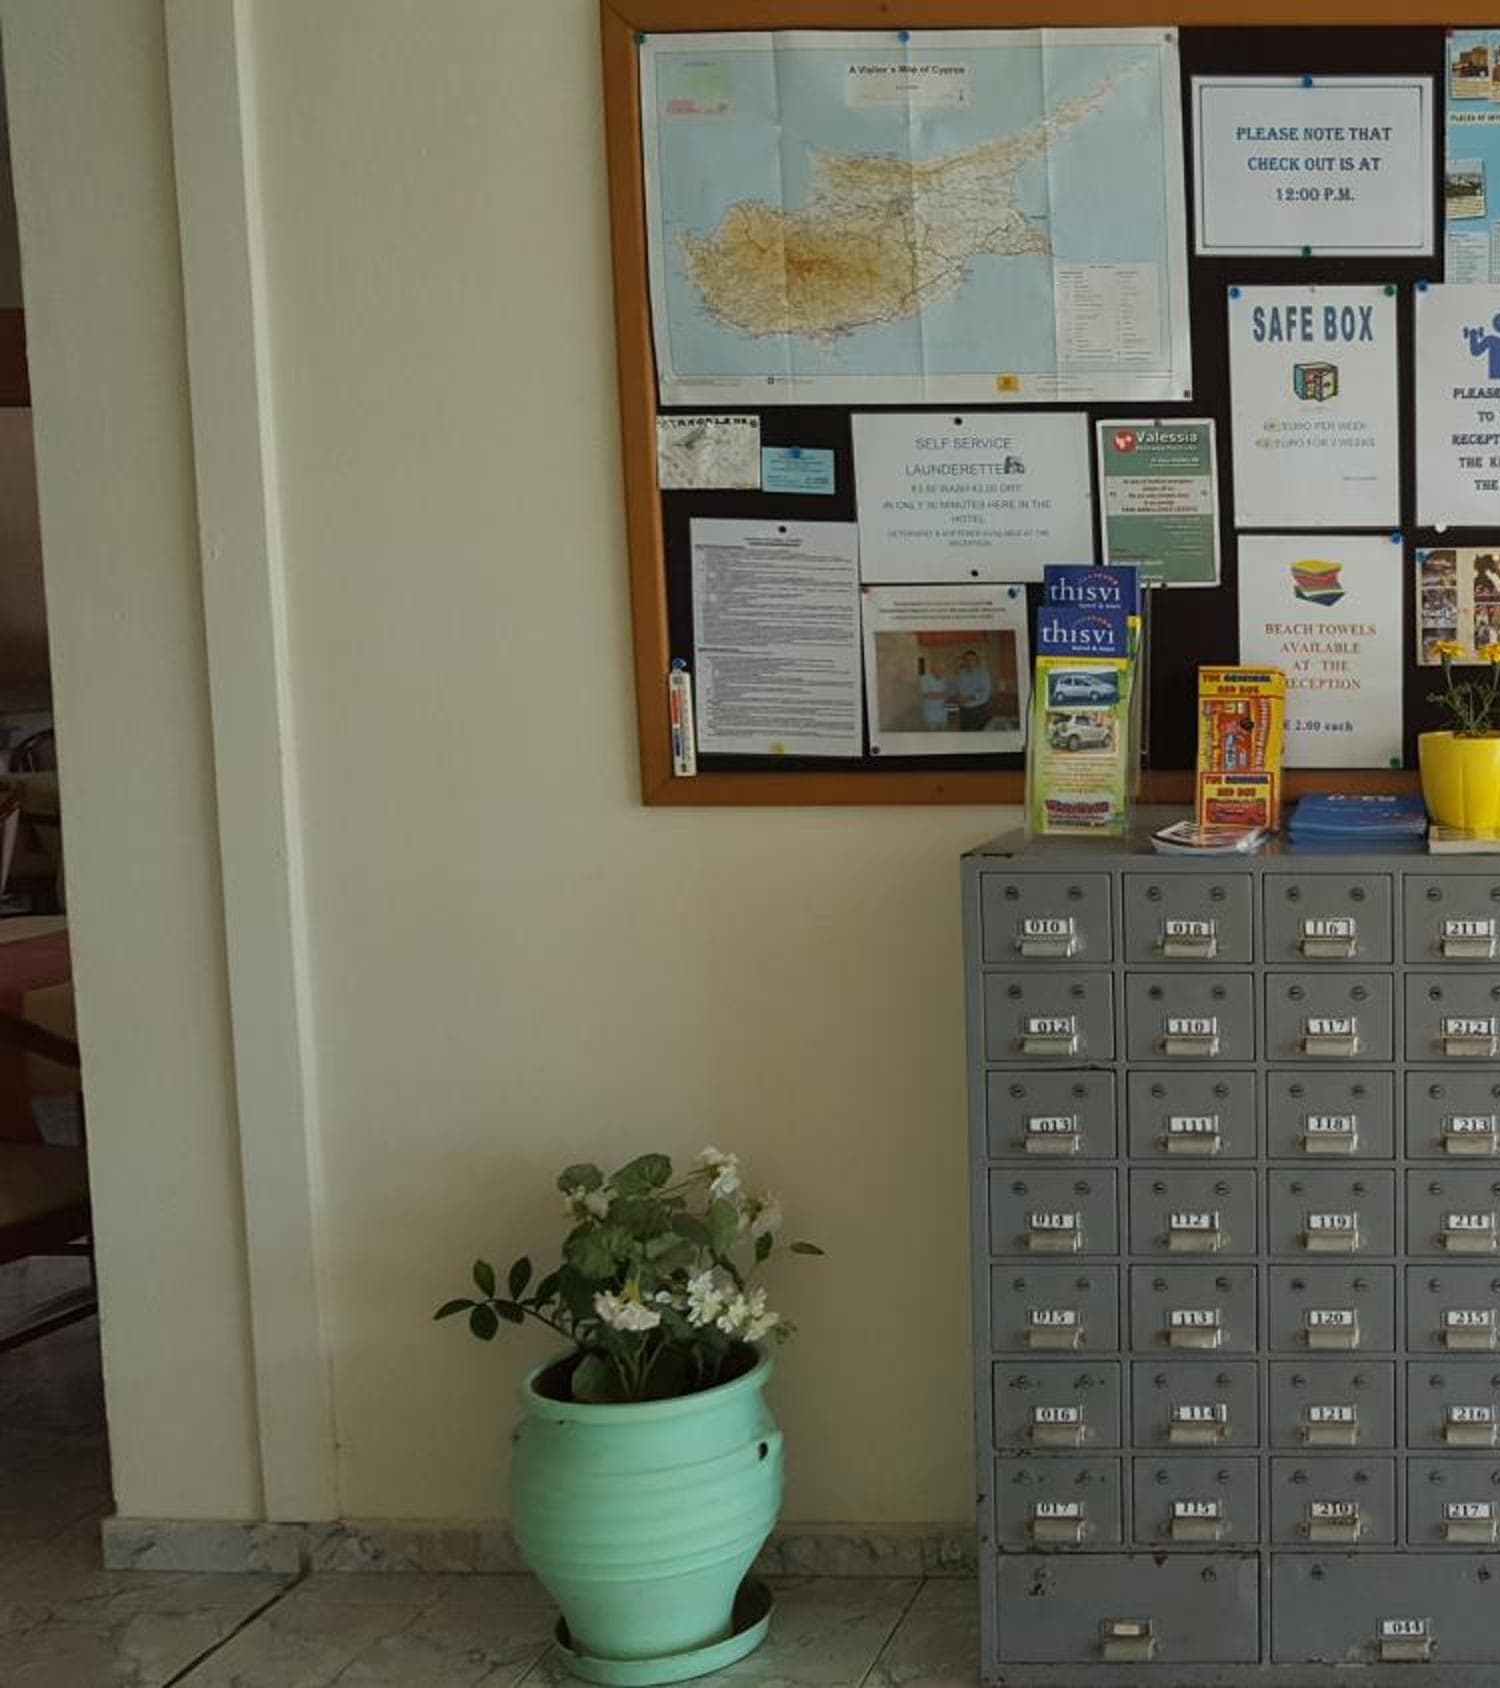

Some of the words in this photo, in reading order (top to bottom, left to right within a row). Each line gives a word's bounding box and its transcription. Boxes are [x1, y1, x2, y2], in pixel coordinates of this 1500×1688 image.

[1236, 127, 1299, 141] PLEASE
[1303, 127, 1345, 141] NOTE
[1349, 127, 1392, 141] THAT
[1248, 157, 1300, 171] CHECK
[1305, 157, 1335, 171] OUT
[1340, 157, 1355, 171] IS
[1359, 157, 1382, 171] AT
[1276, 187, 1319, 201] 12:00
[1324, 187, 1355, 201] P.M.
[1253, 306, 1313, 342] SAFE
[1324, 306, 1374, 341] BOX
[1477, 411, 1494, 422] TO
[1136, 432, 1197, 443] Valessia
[915, 438, 949, 450] SELF
[953, 438, 1012, 450] SERVICE
[1459, 457, 1482, 468] THE
[905, 464, 1005, 476] LAUNDERETTE
[1474, 480, 1498, 491] THE
[1051, 577, 1120, 601] thisvi
[1043, 619, 1114, 644] thisvi
[1265, 624, 1313, 635] BEACH
[1318, 624, 1376, 636] TOWELS
[1280, 643, 1360, 654] AVAILABLE
[1294, 661, 1310, 672] AT
[1322, 661, 1348, 672] THE
[1295, 720, 1321, 731] 2.00
[1324, 720, 1353, 731] each
[1031, 921, 1060, 933] 010
[1450, 922, 1478, 934] 211
[1318, 1020, 1344, 1033] 117
[1454, 1022, 1483, 1034] 212
[1461, 1119, 1488, 1131] 213
